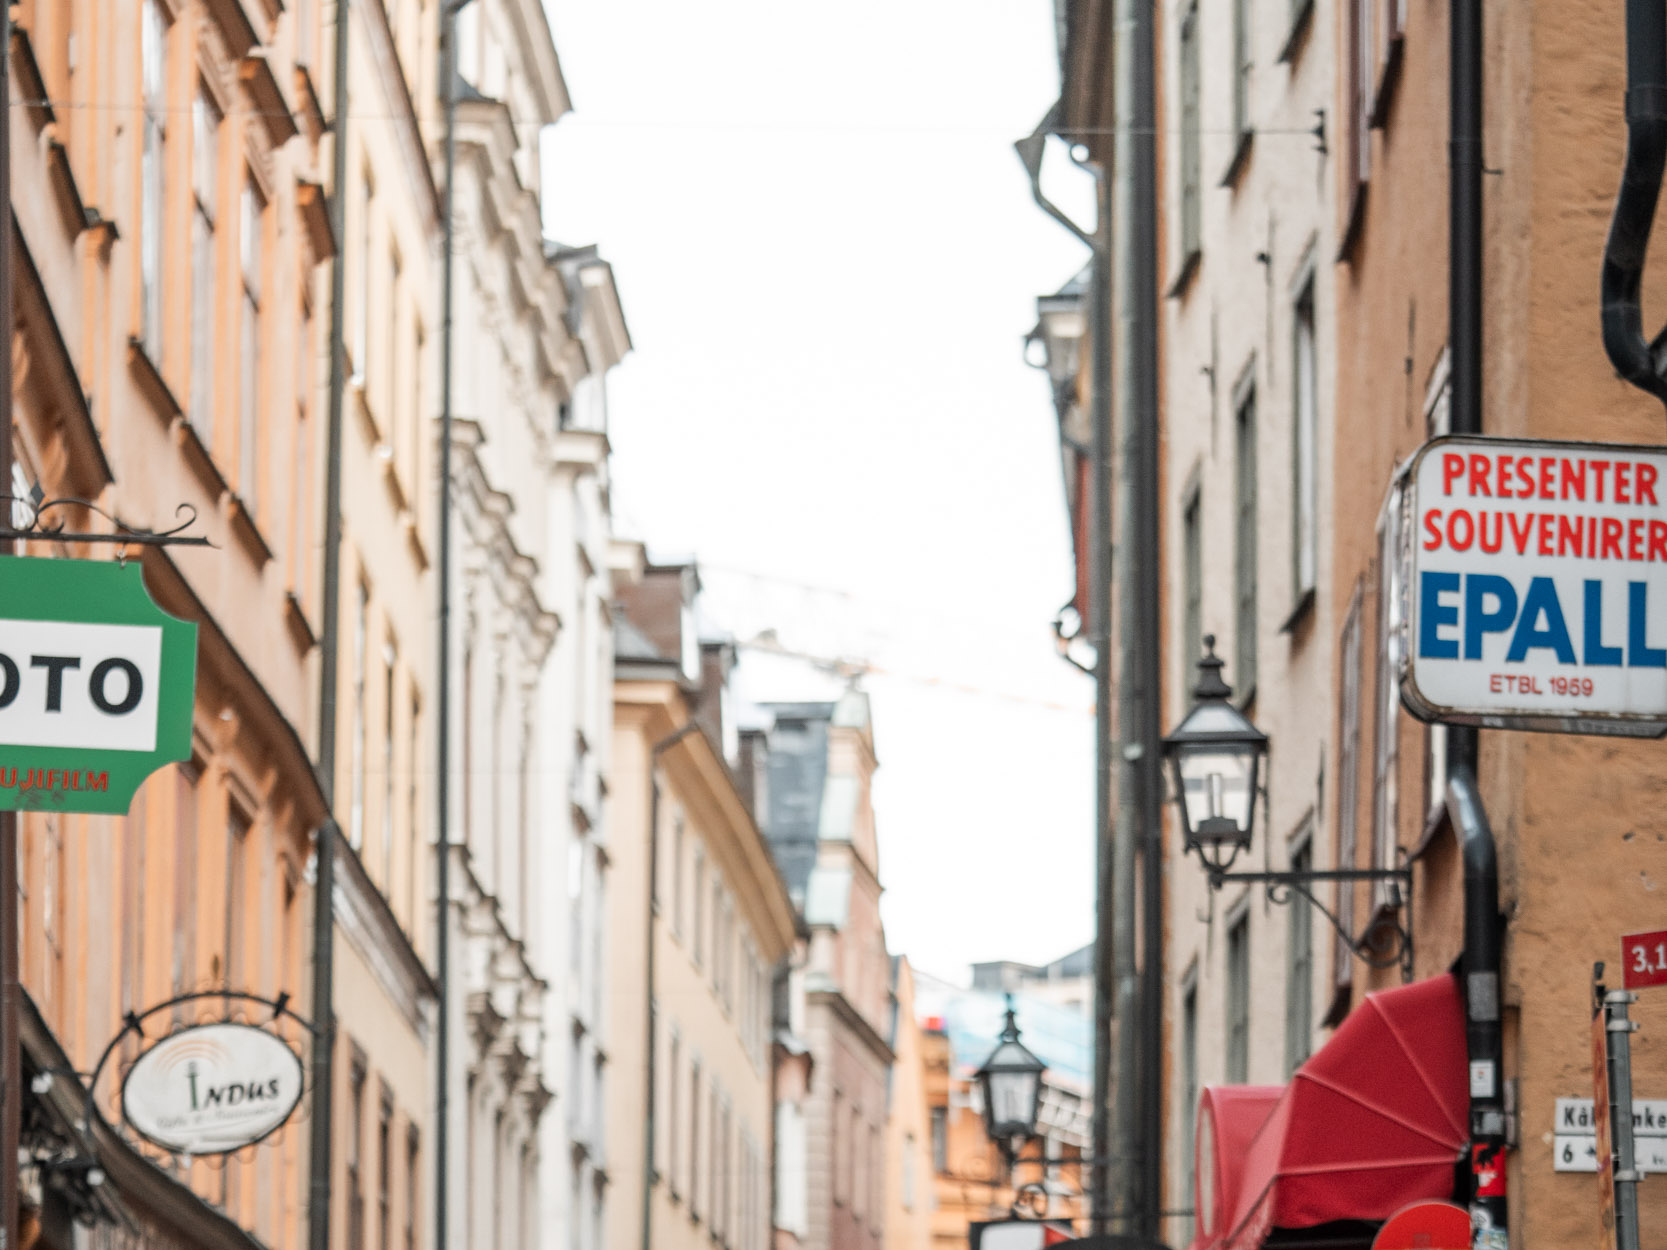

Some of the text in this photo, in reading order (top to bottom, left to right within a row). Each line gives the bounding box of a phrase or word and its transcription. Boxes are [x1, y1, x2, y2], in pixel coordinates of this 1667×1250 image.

[1443, 453, 1659, 505] PRESENTER
[1423, 509, 1667, 563] SOUVENIRER
[1419, 571, 1667, 667] EPALL
[1490, 674, 1594, 697] ETBL 1959
